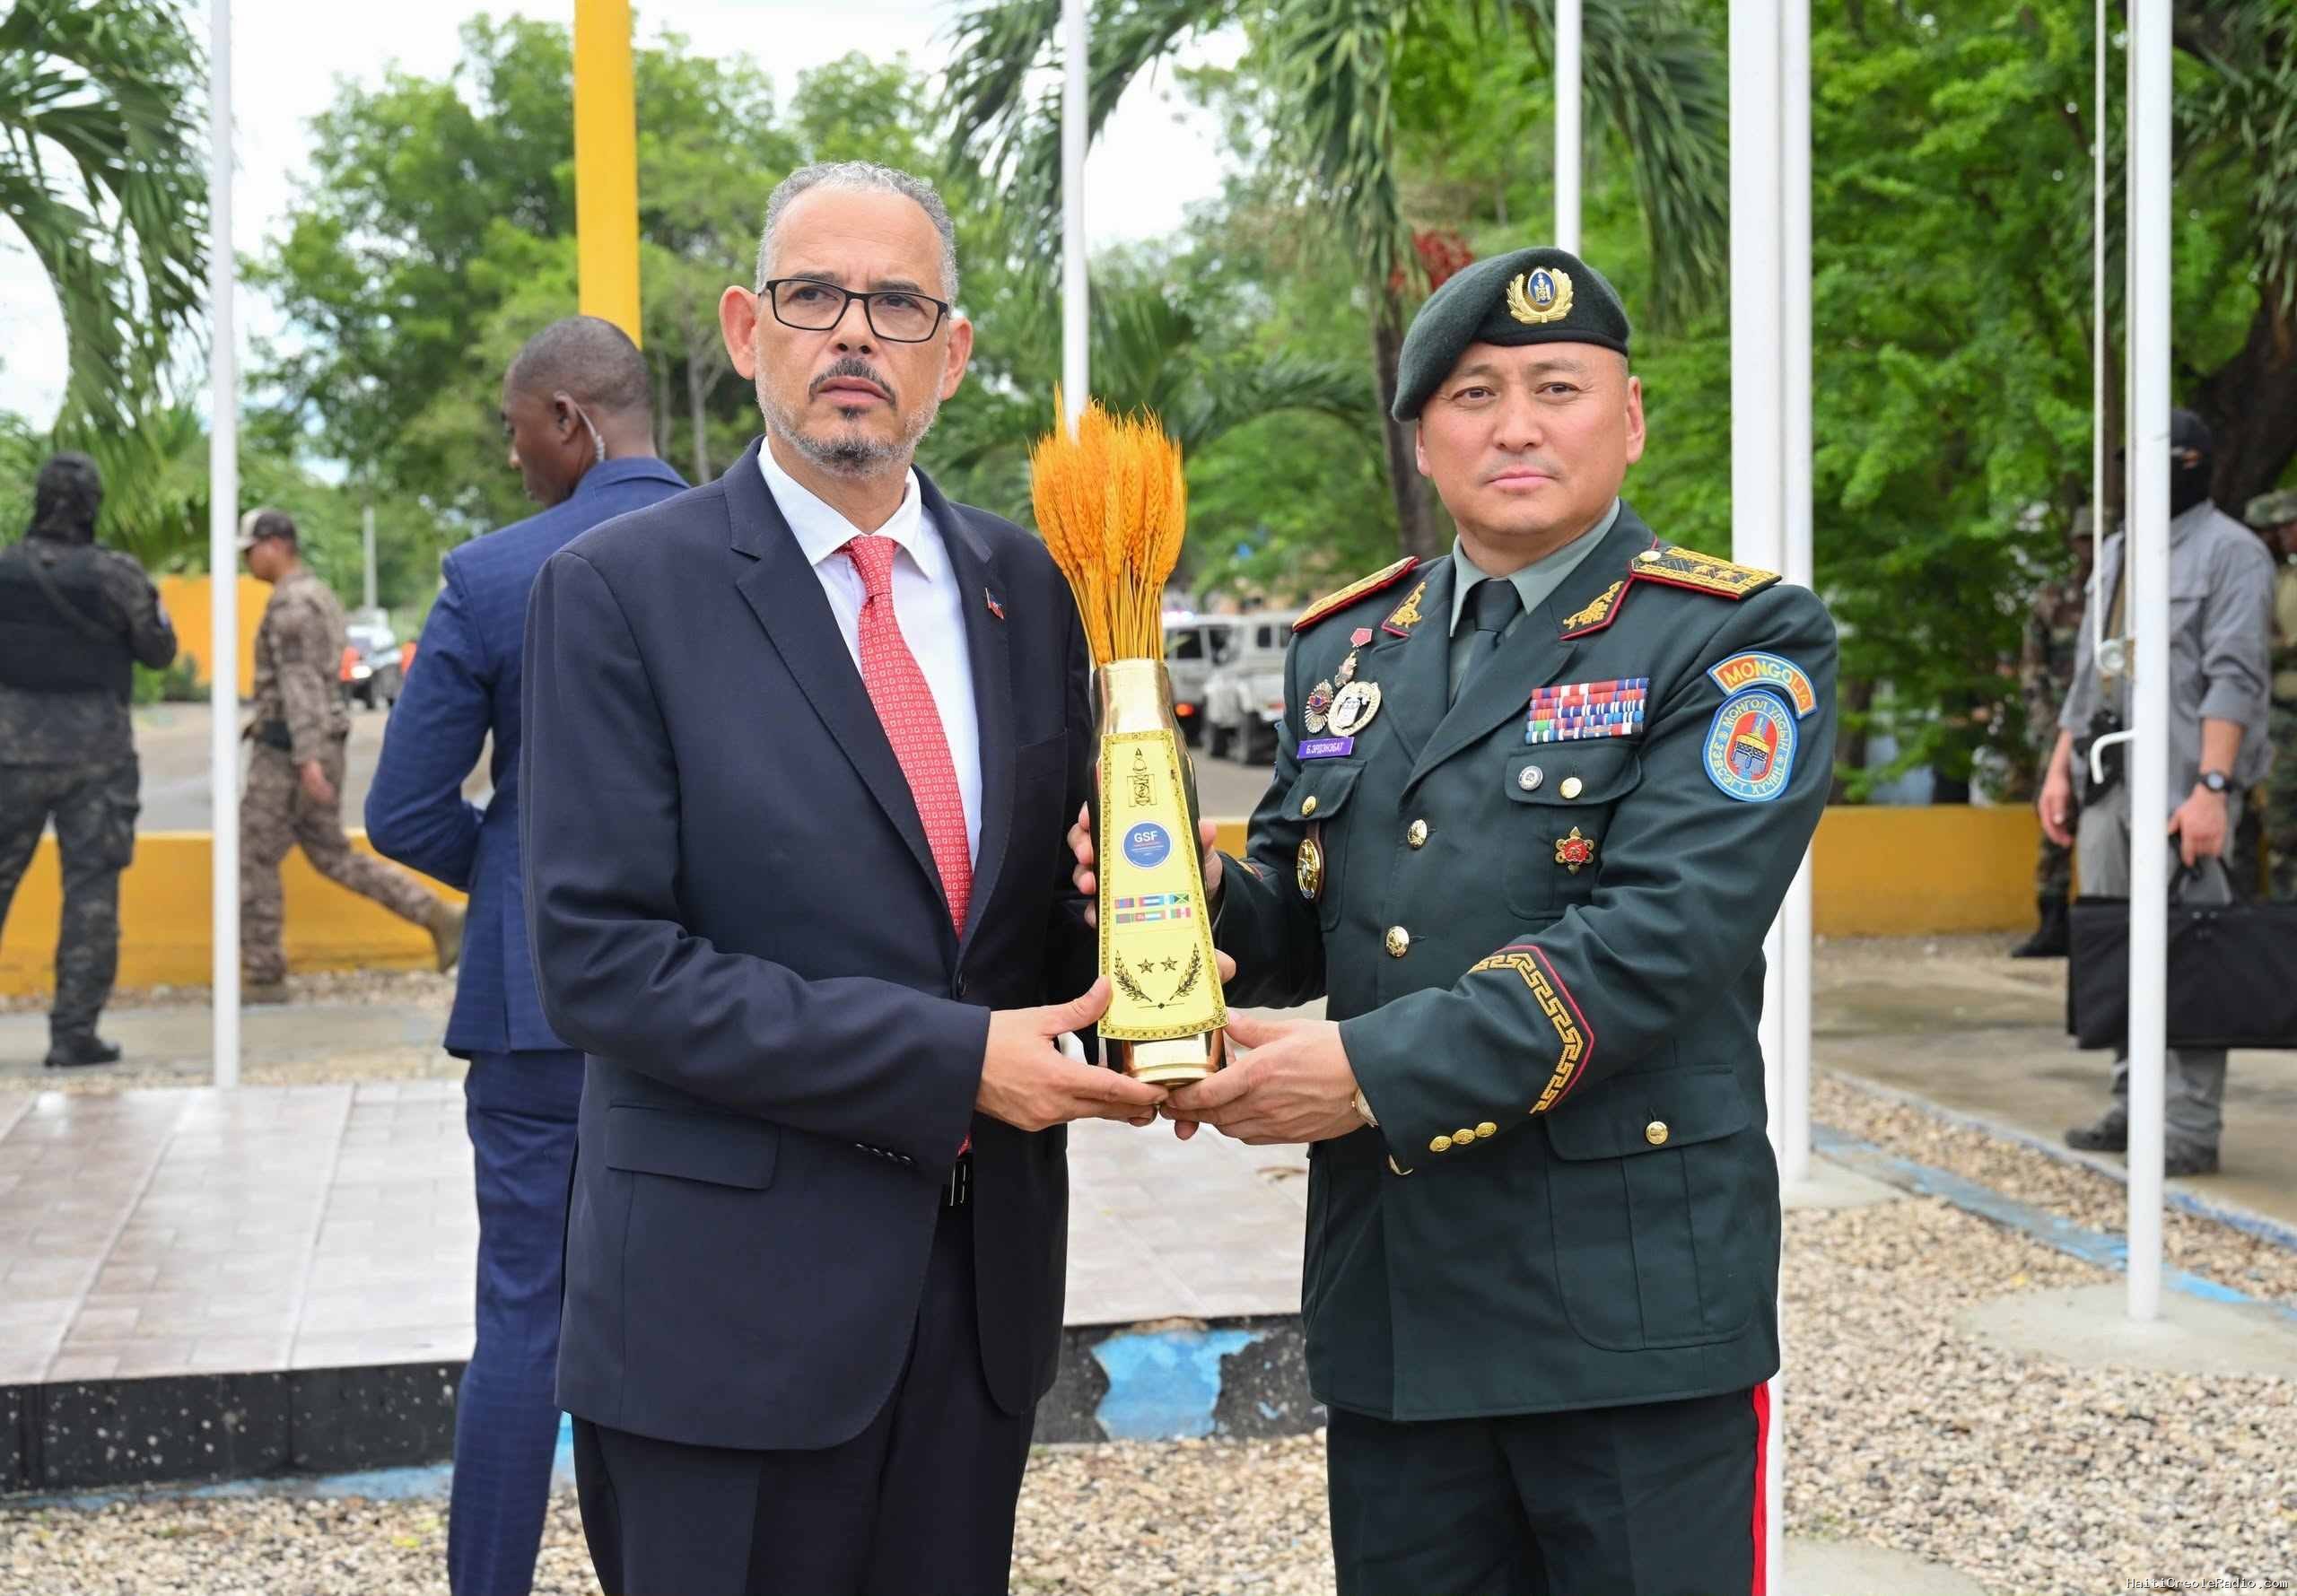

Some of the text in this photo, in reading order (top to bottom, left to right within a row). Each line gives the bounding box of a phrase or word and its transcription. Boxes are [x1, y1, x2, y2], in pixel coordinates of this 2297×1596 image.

[1723, 660, 1808, 704] MONGOLIA
[1723, 699, 1768, 728] МОНГОЛ
[1134, 831, 1157, 842] GSF
